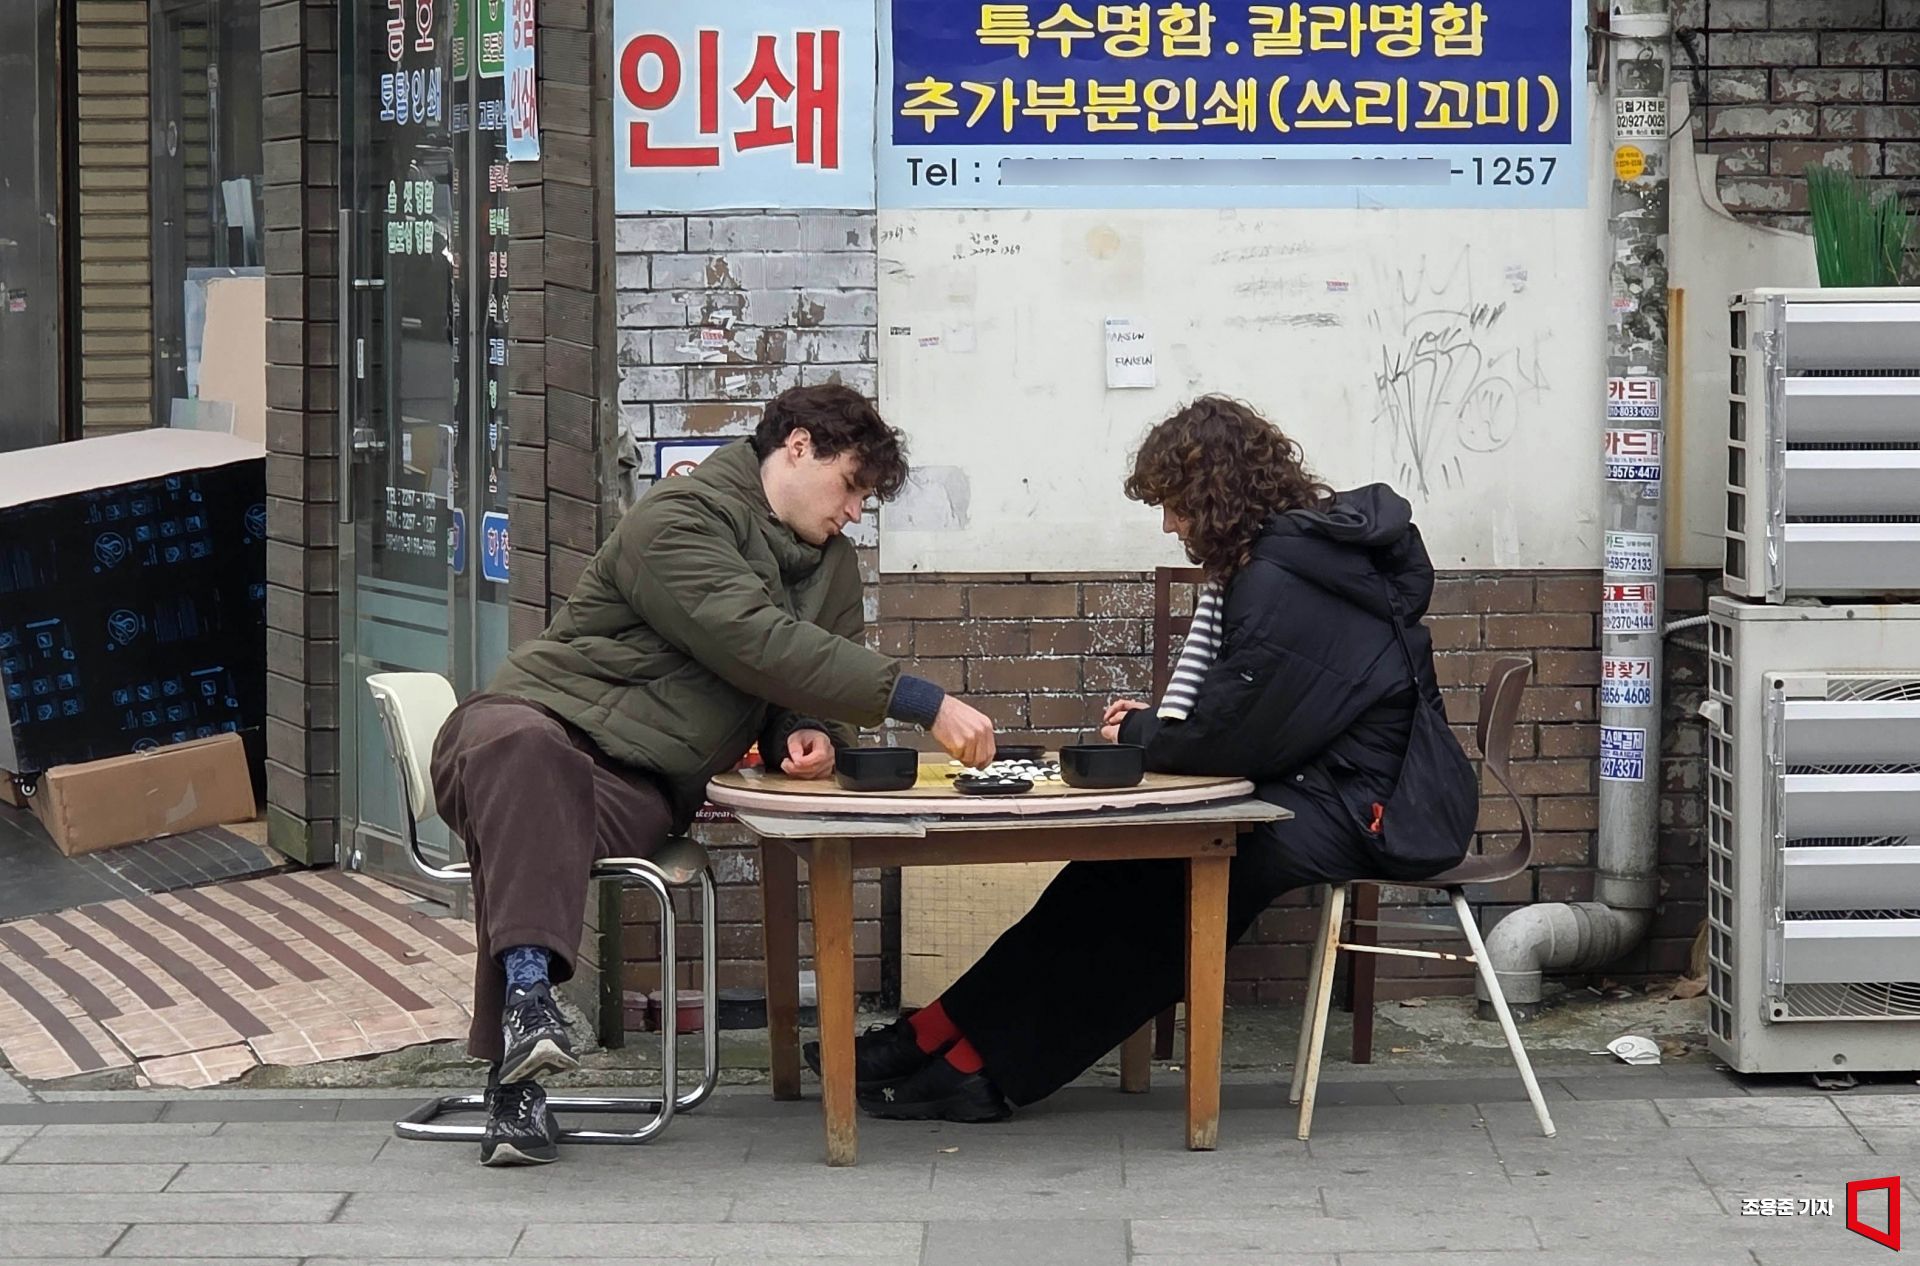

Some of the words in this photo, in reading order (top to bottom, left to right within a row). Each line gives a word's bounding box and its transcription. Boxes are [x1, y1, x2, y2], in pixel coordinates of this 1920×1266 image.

[380, 66, 441, 126] 토탈인쇄
[511, 66, 536, 140] 인쇄
[618, 28, 841, 171] 인쇄
[899, 74, 1560, 134] 추가부분인쇄(쓰리꼬미)
[907, 157, 957, 186] Tel
[1608, 380, 1648, 400] 카드
[1603, 586, 1642, 600] 카드
[1603, 661, 1651, 679] 람찾기
